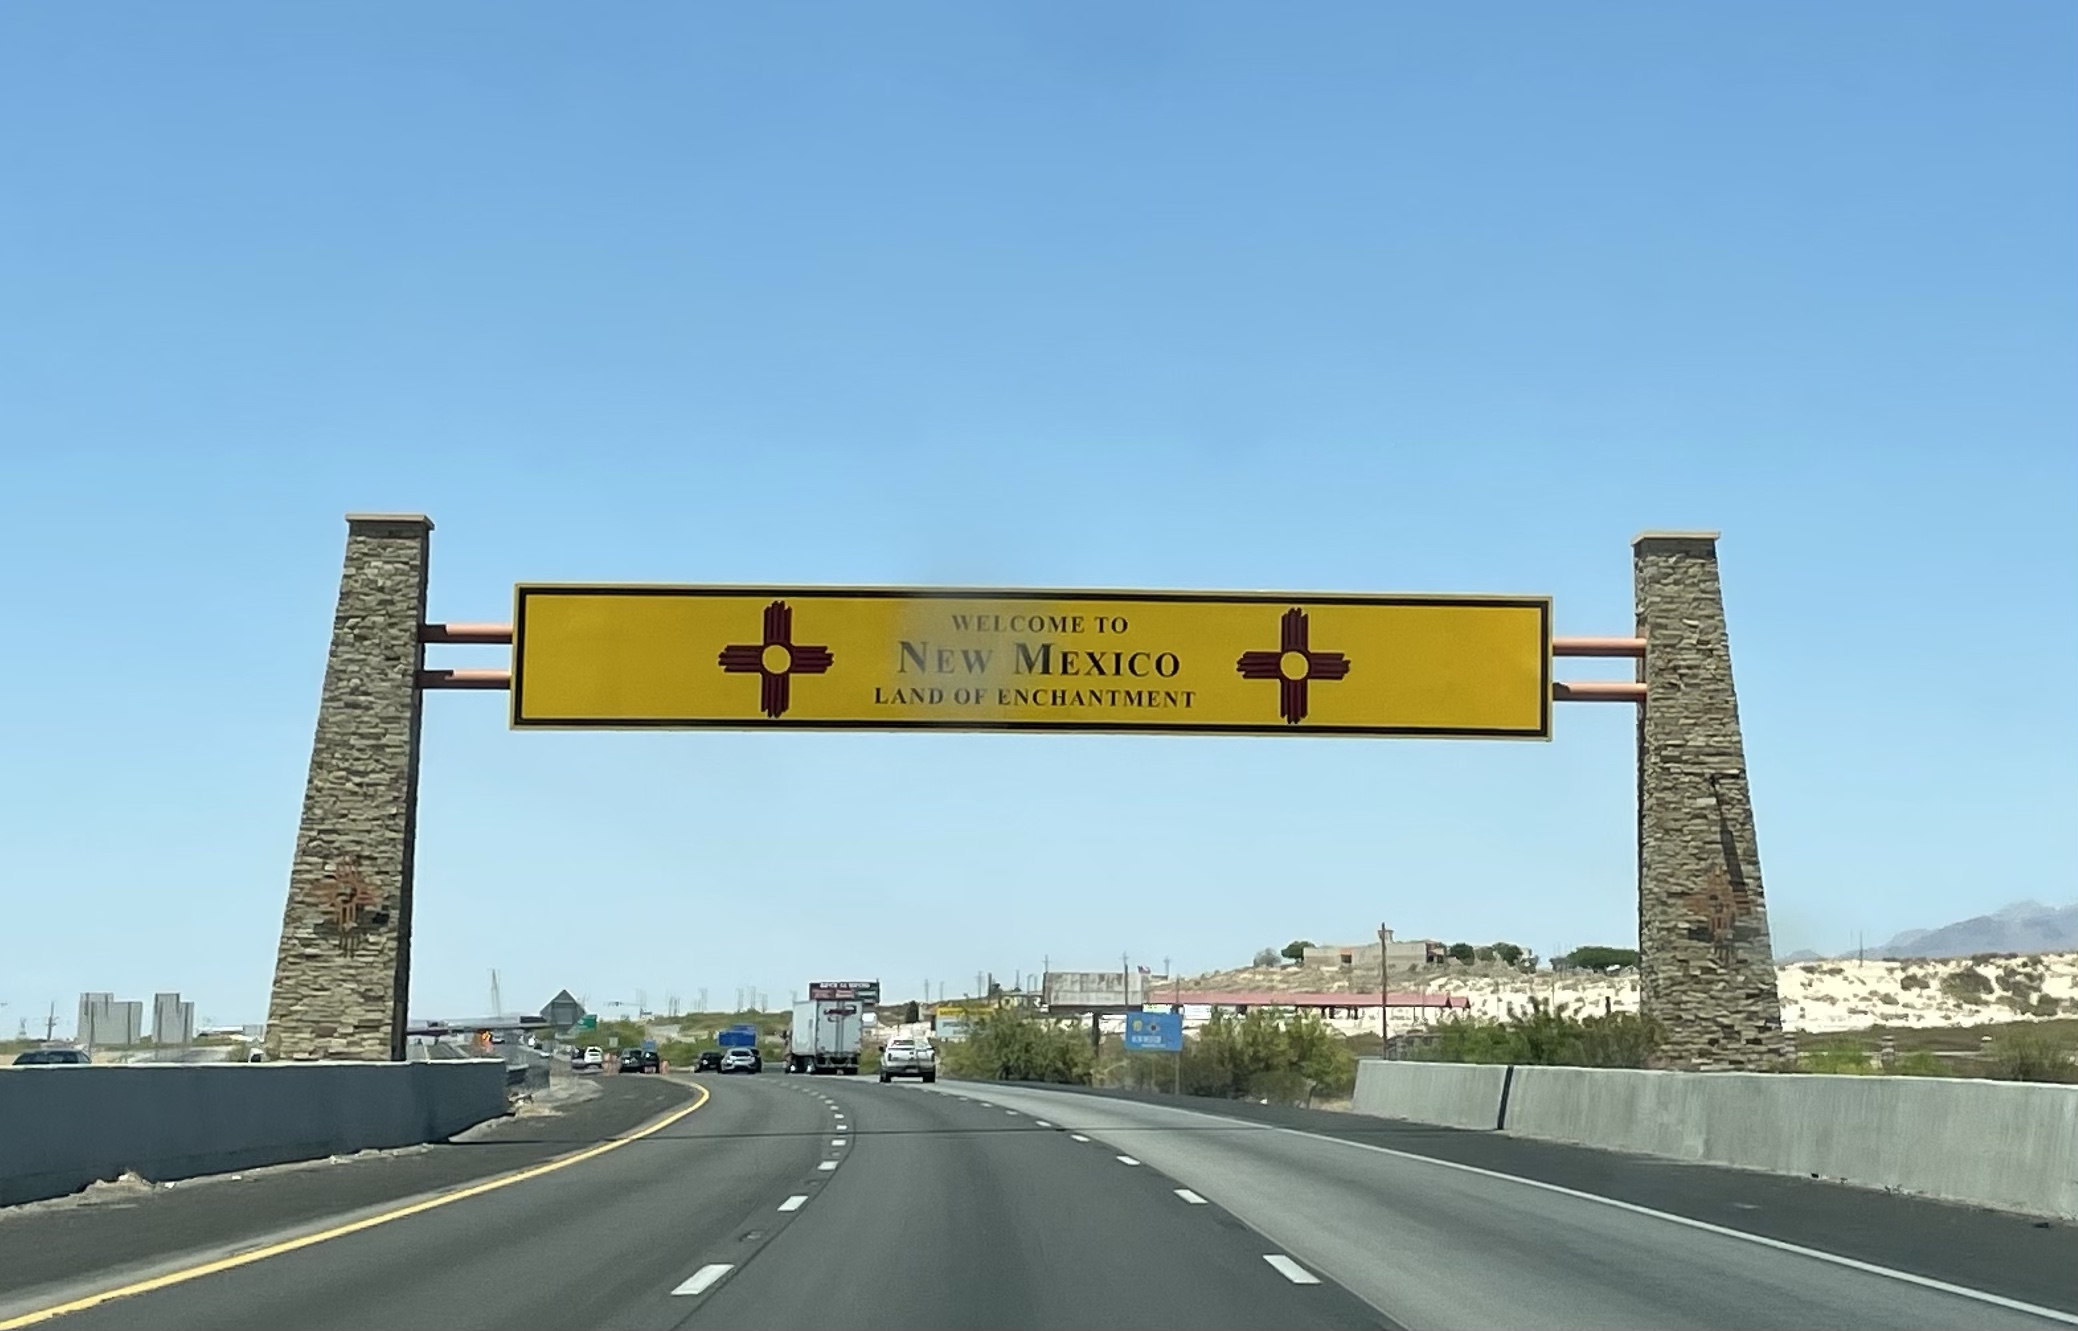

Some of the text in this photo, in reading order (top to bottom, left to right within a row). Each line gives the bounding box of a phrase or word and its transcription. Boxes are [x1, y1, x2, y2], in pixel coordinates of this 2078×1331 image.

[952, 615, 1129, 634] WELCOME TO
[874, 687, 1196, 709] LAND OF ENCHANTMENT
